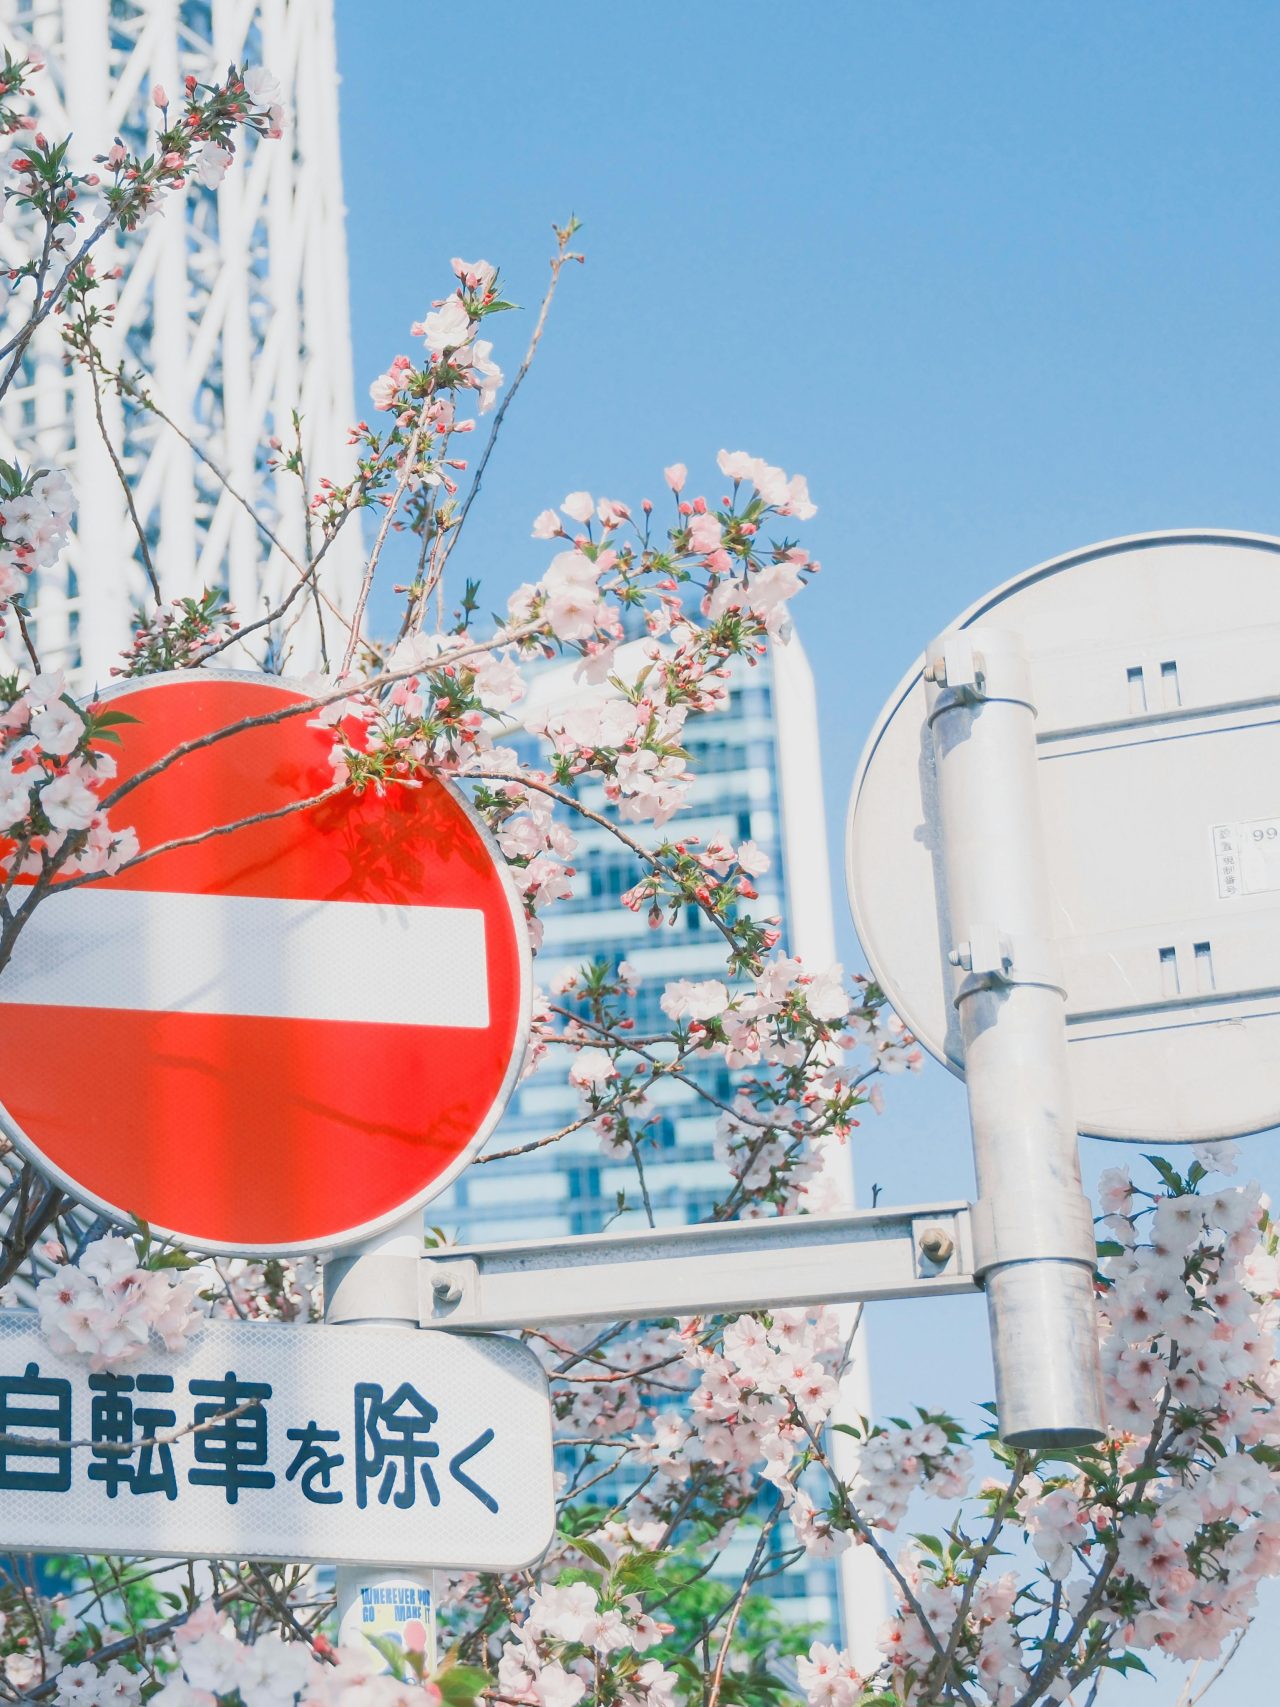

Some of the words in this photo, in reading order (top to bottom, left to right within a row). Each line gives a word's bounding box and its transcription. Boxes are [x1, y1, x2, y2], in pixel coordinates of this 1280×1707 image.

[361, 1588, 416, 1605] WHEREVER
[418, 1590, 430, 1606] YOU
[363, 1606, 375, 1622] GO
[395, 1606, 422, 1621] MAKE
